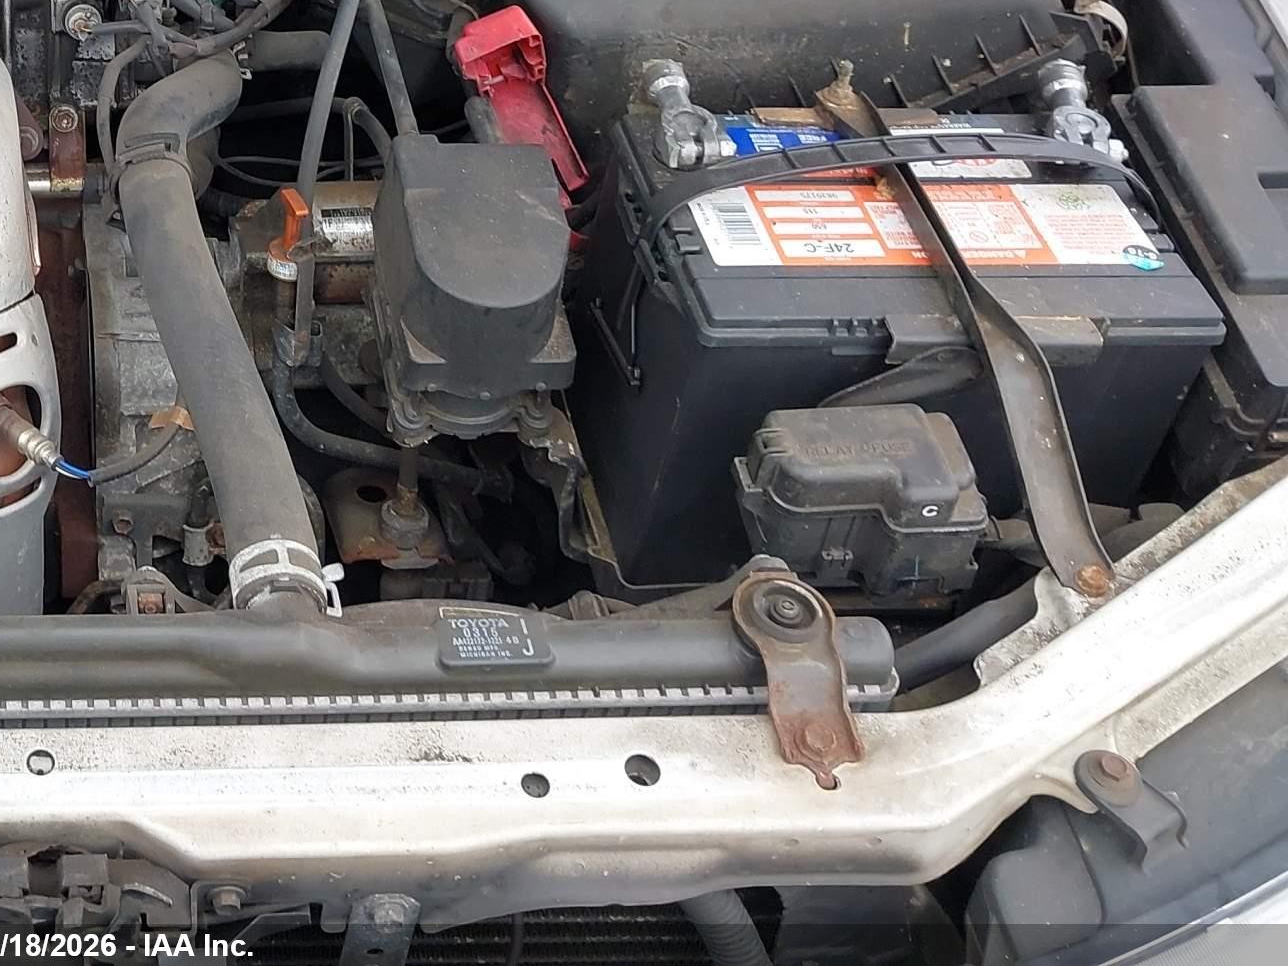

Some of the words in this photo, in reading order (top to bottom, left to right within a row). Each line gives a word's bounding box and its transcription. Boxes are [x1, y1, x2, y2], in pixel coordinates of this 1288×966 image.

[803, 242, 855, 254] 24F-C
[921, 505, 939, 518] C
[448, 618, 509, 629] TOYOTA
[459, 650, 496, 658] MICHIGAN
